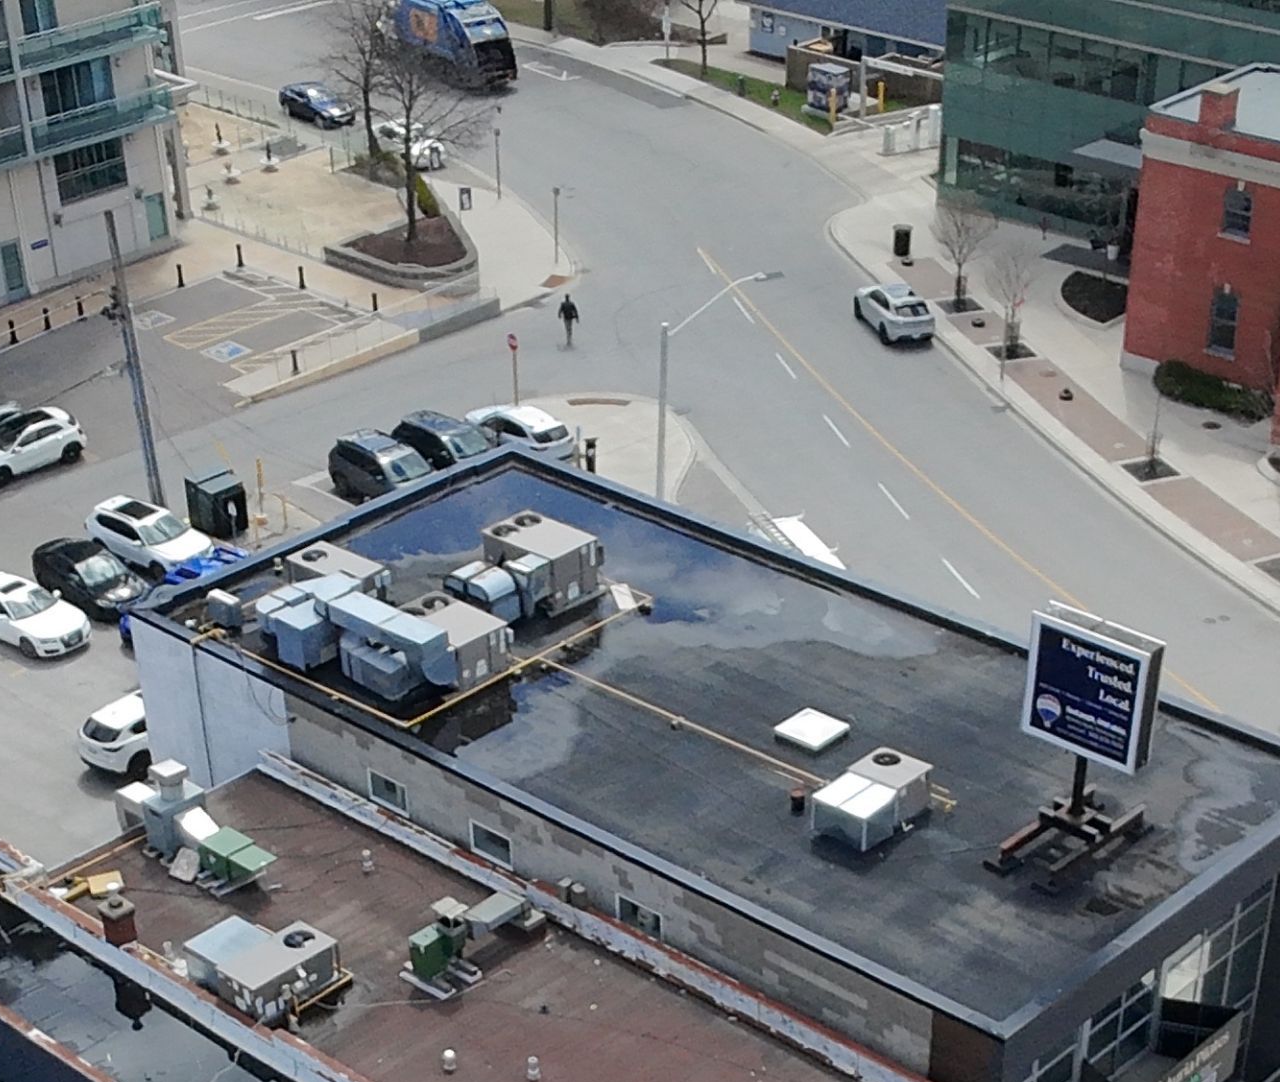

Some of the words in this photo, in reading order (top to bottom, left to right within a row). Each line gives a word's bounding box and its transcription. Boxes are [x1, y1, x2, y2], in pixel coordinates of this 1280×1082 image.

[1062, 637, 1135, 676] Experienced.
[1086, 665, 1133, 694] Trusted.
[1098, 689, 1131, 712] Local.
